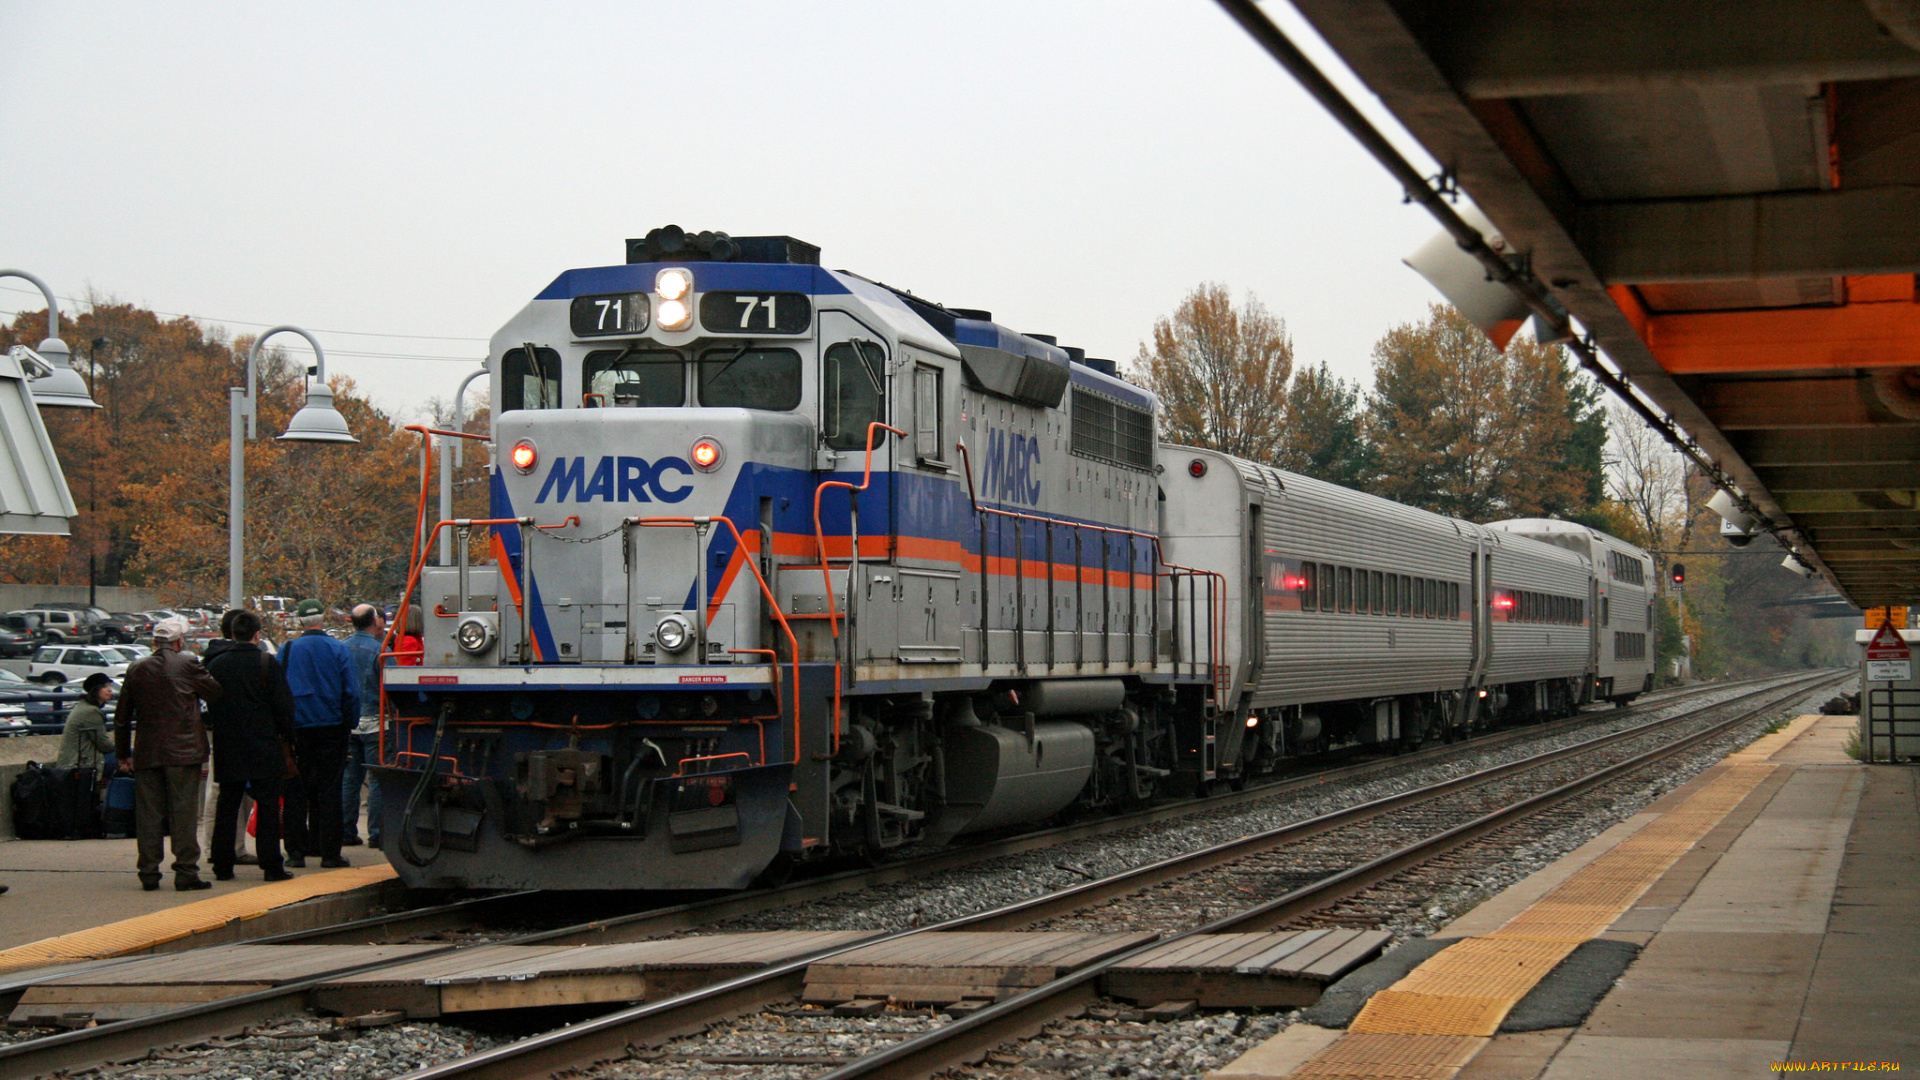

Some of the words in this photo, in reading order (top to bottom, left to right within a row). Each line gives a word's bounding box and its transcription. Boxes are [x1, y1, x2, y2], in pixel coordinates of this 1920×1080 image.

[595, 300, 622, 330] 71
[736, 296, 776, 329] 71
[535, 456, 694, 504] MARC
[981, 427, 1040, 506] MARC
[925, 607, 936, 641] 71
